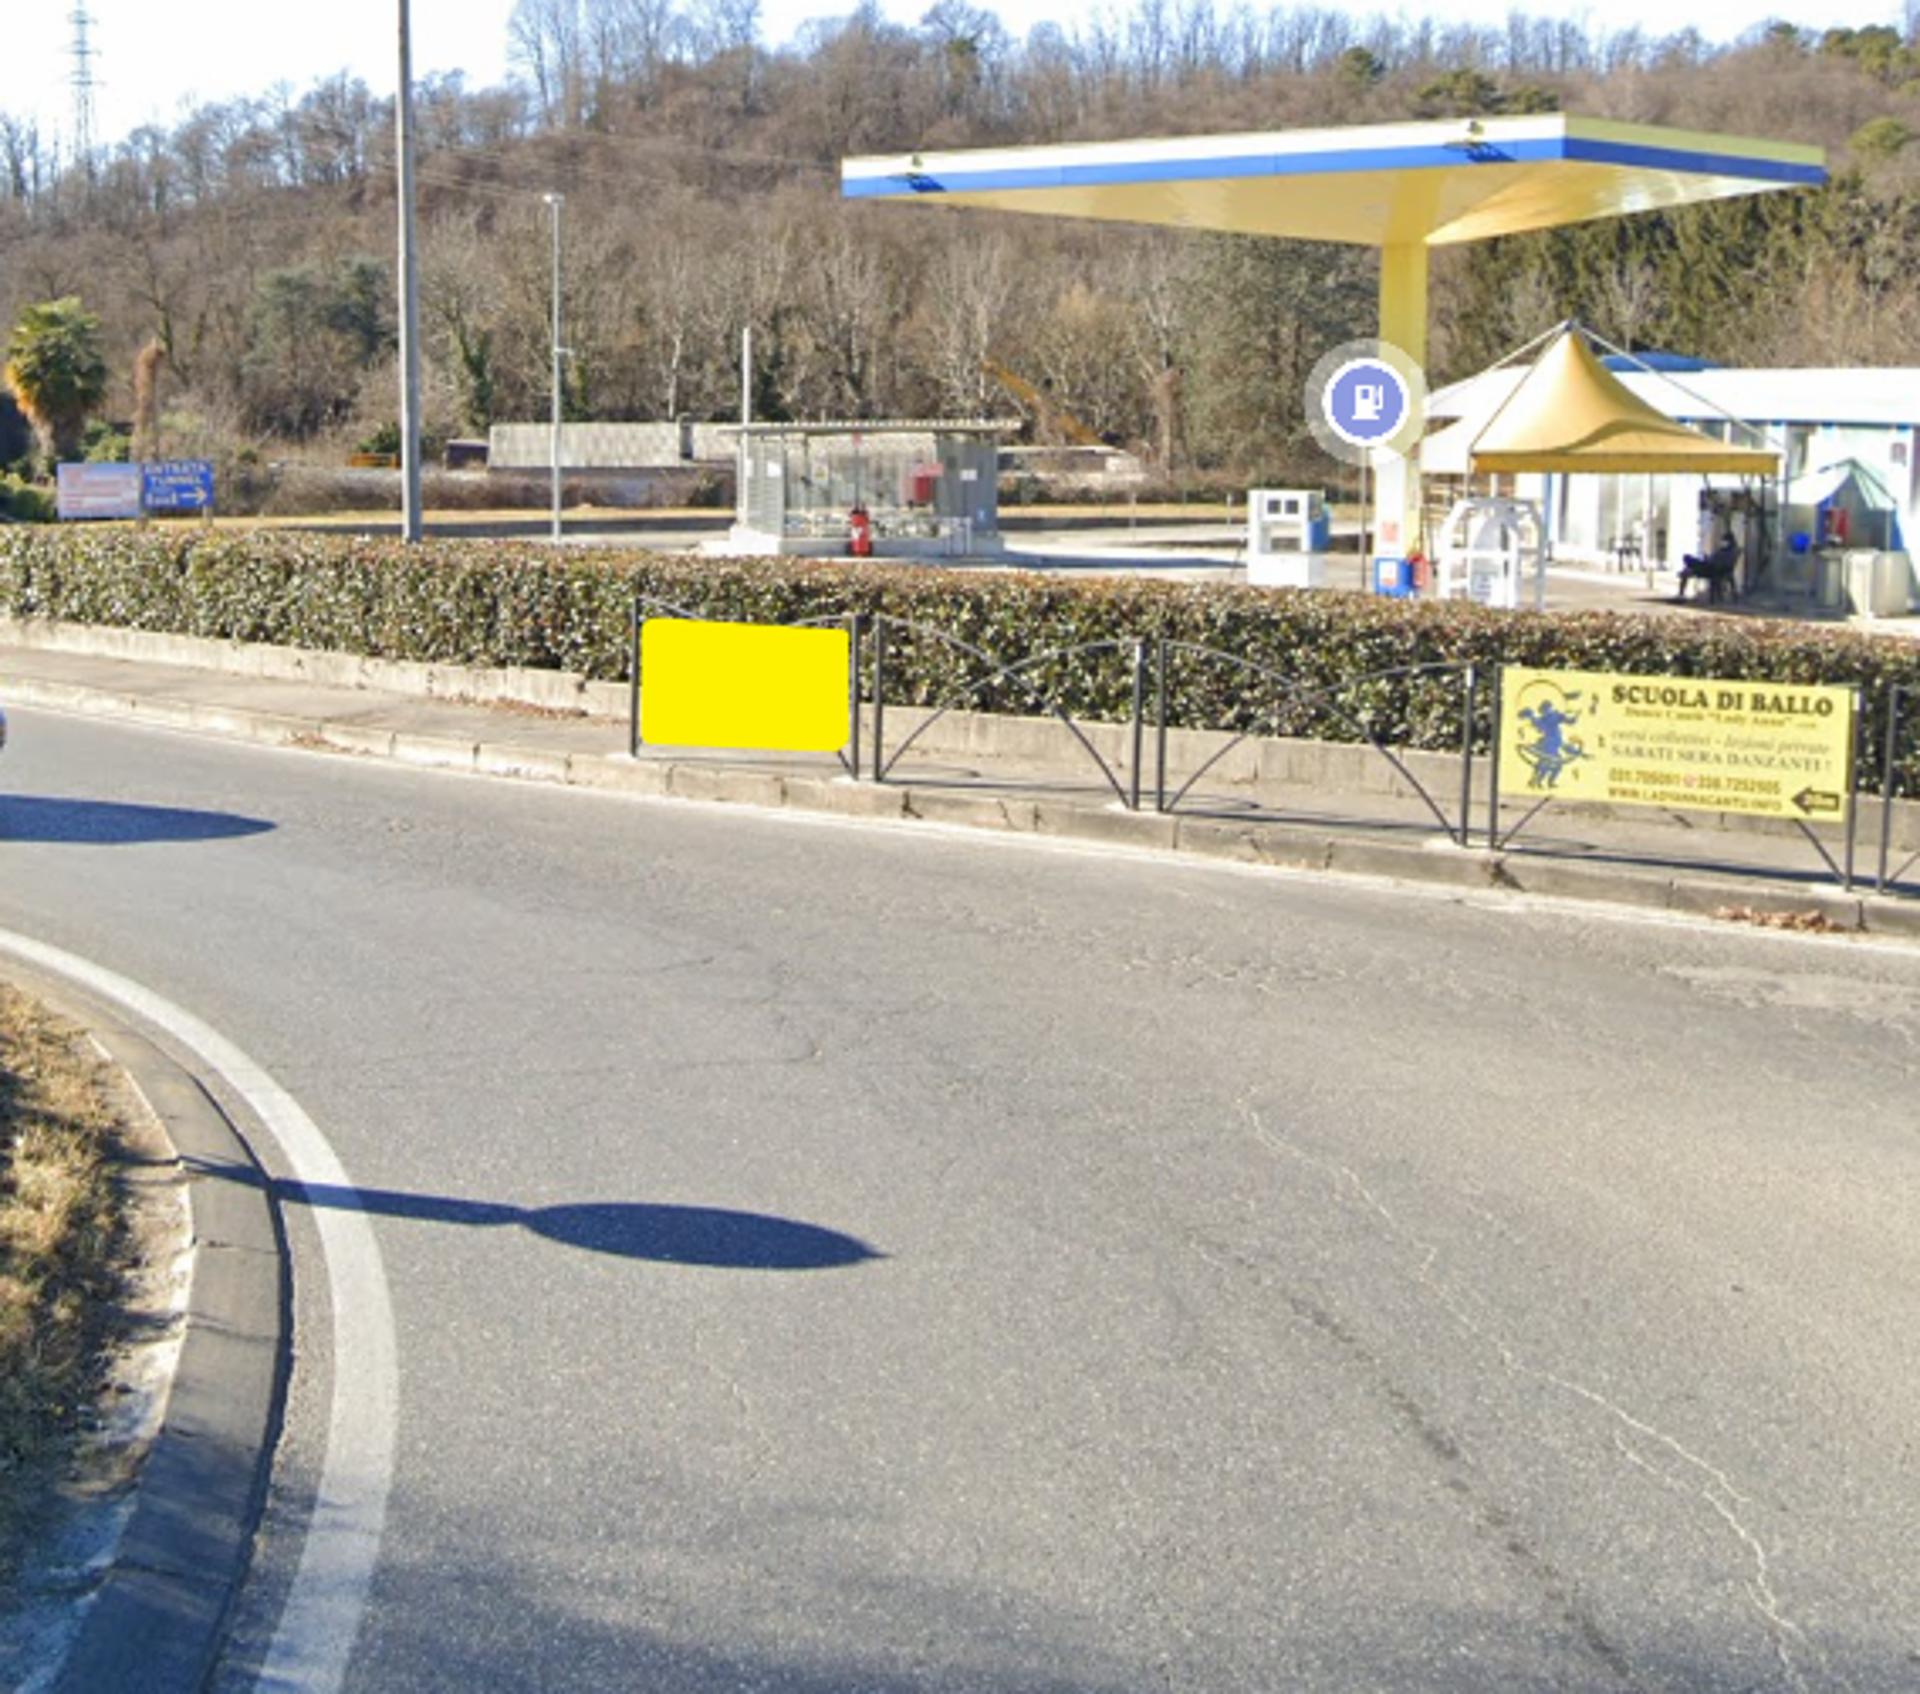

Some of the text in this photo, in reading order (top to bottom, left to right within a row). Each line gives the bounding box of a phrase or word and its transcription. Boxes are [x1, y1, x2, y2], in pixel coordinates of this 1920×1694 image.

[1612, 685, 1833, 716] SCUOLA DI BALLO
[1726, 753, 1819, 771] DANZANTI
